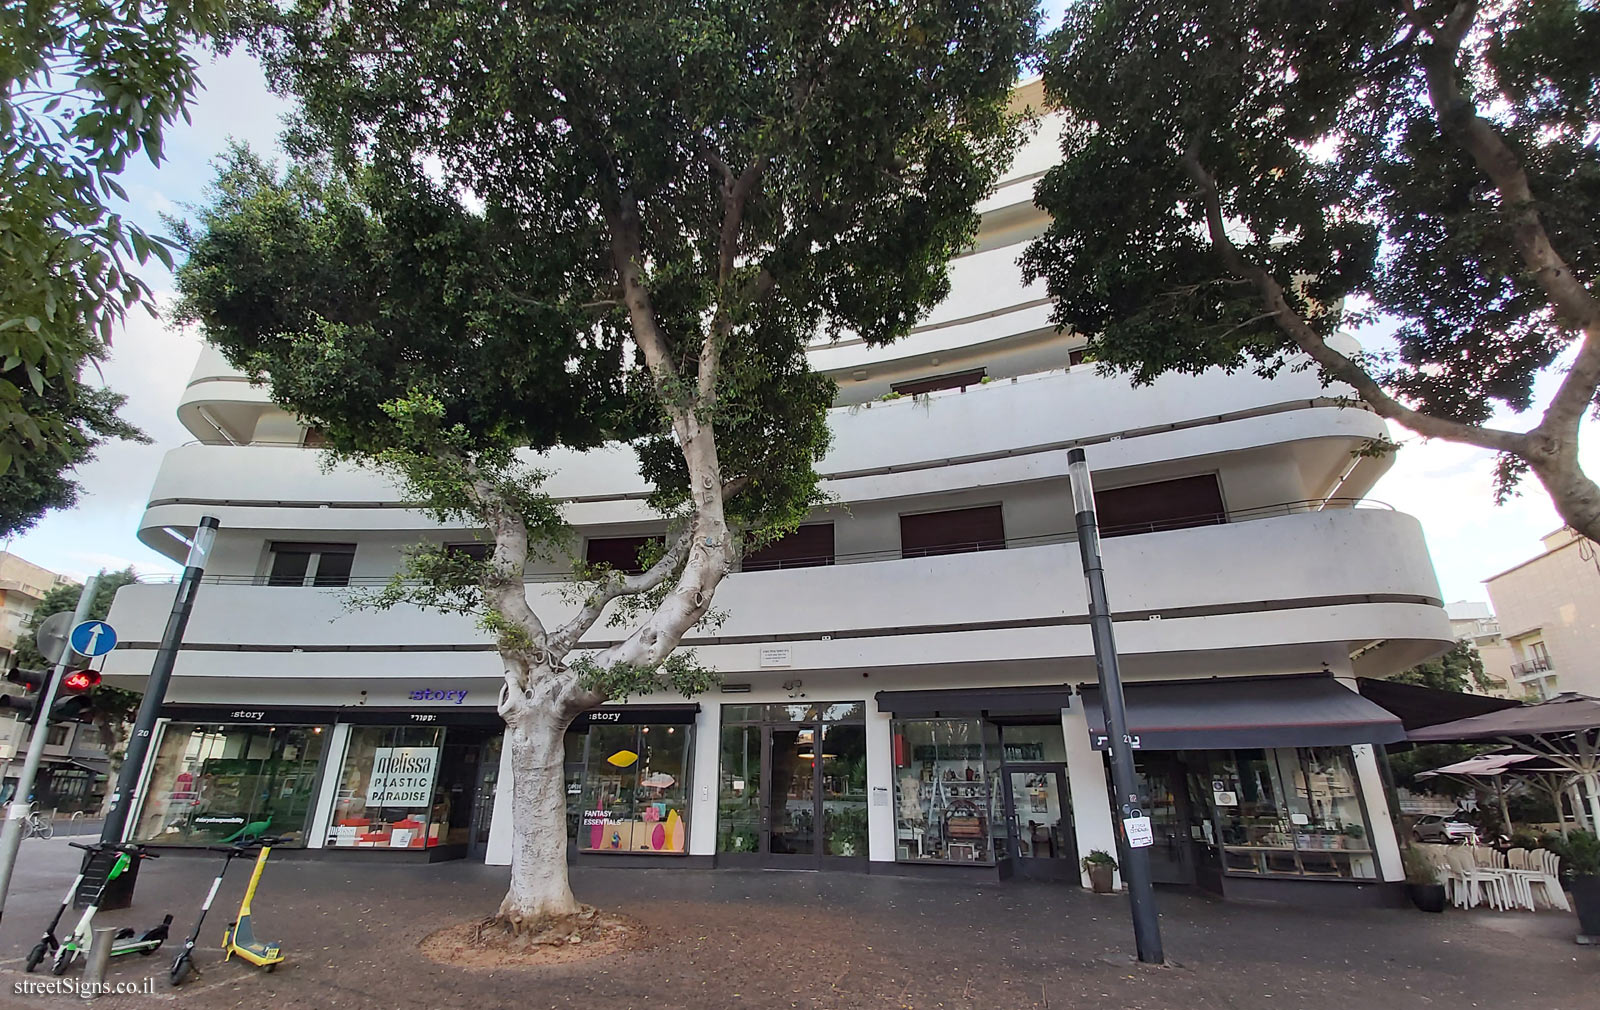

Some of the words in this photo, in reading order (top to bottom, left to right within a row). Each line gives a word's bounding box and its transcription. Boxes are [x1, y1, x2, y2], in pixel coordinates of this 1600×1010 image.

[408, 688, 468, 704] :story
[230, 710, 265, 720] :story
[588, 713, 620, 721] :story
[137, 729, 149, 737] 20
[376, 752, 431, 774] melissa
[374, 777, 428, 788] PLASTIC
[371, 791, 426, 801] PARADISE
